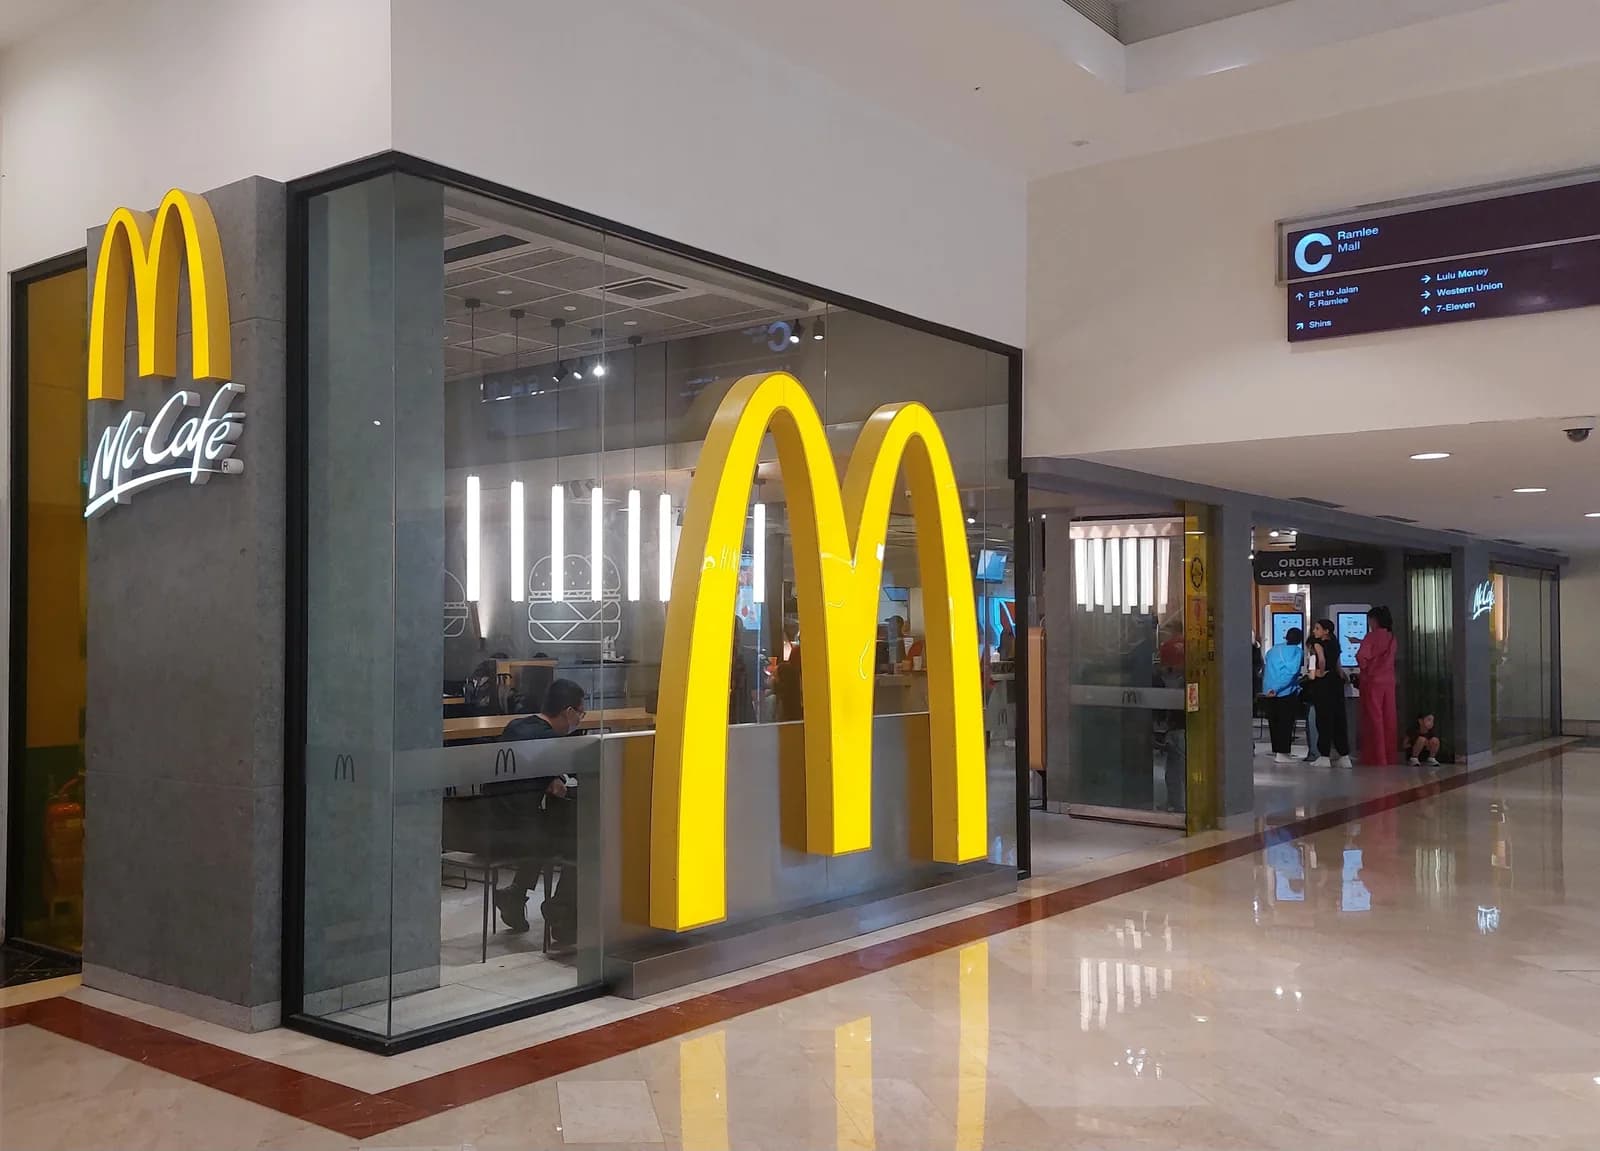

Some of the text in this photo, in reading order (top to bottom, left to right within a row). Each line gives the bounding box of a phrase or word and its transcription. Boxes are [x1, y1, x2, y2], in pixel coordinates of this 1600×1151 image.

[1337, 227, 1379, 241] Ramlee
[1294, 232, 1333, 273] C
[1337, 240, 1361, 253] Mall
[1436, 268, 1489, 281] Lulu Money
[1308, 290, 1324, 299] Exit
[1336, 286, 1359, 295] Jalan
[1436, 282, 1503, 297] Western Union
[1308, 297, 1349, 309] P. Ramlee
[1436, 301, 1476, 313] 7-Eleven
[1308, 320, 1332, 329] Shins
[84, 382, 247, 518] McCafé
[1278, 556, 1354, 568] ORDER HERE
[1260, 567, 1374, 578] CASH & CARD PAYMENT
